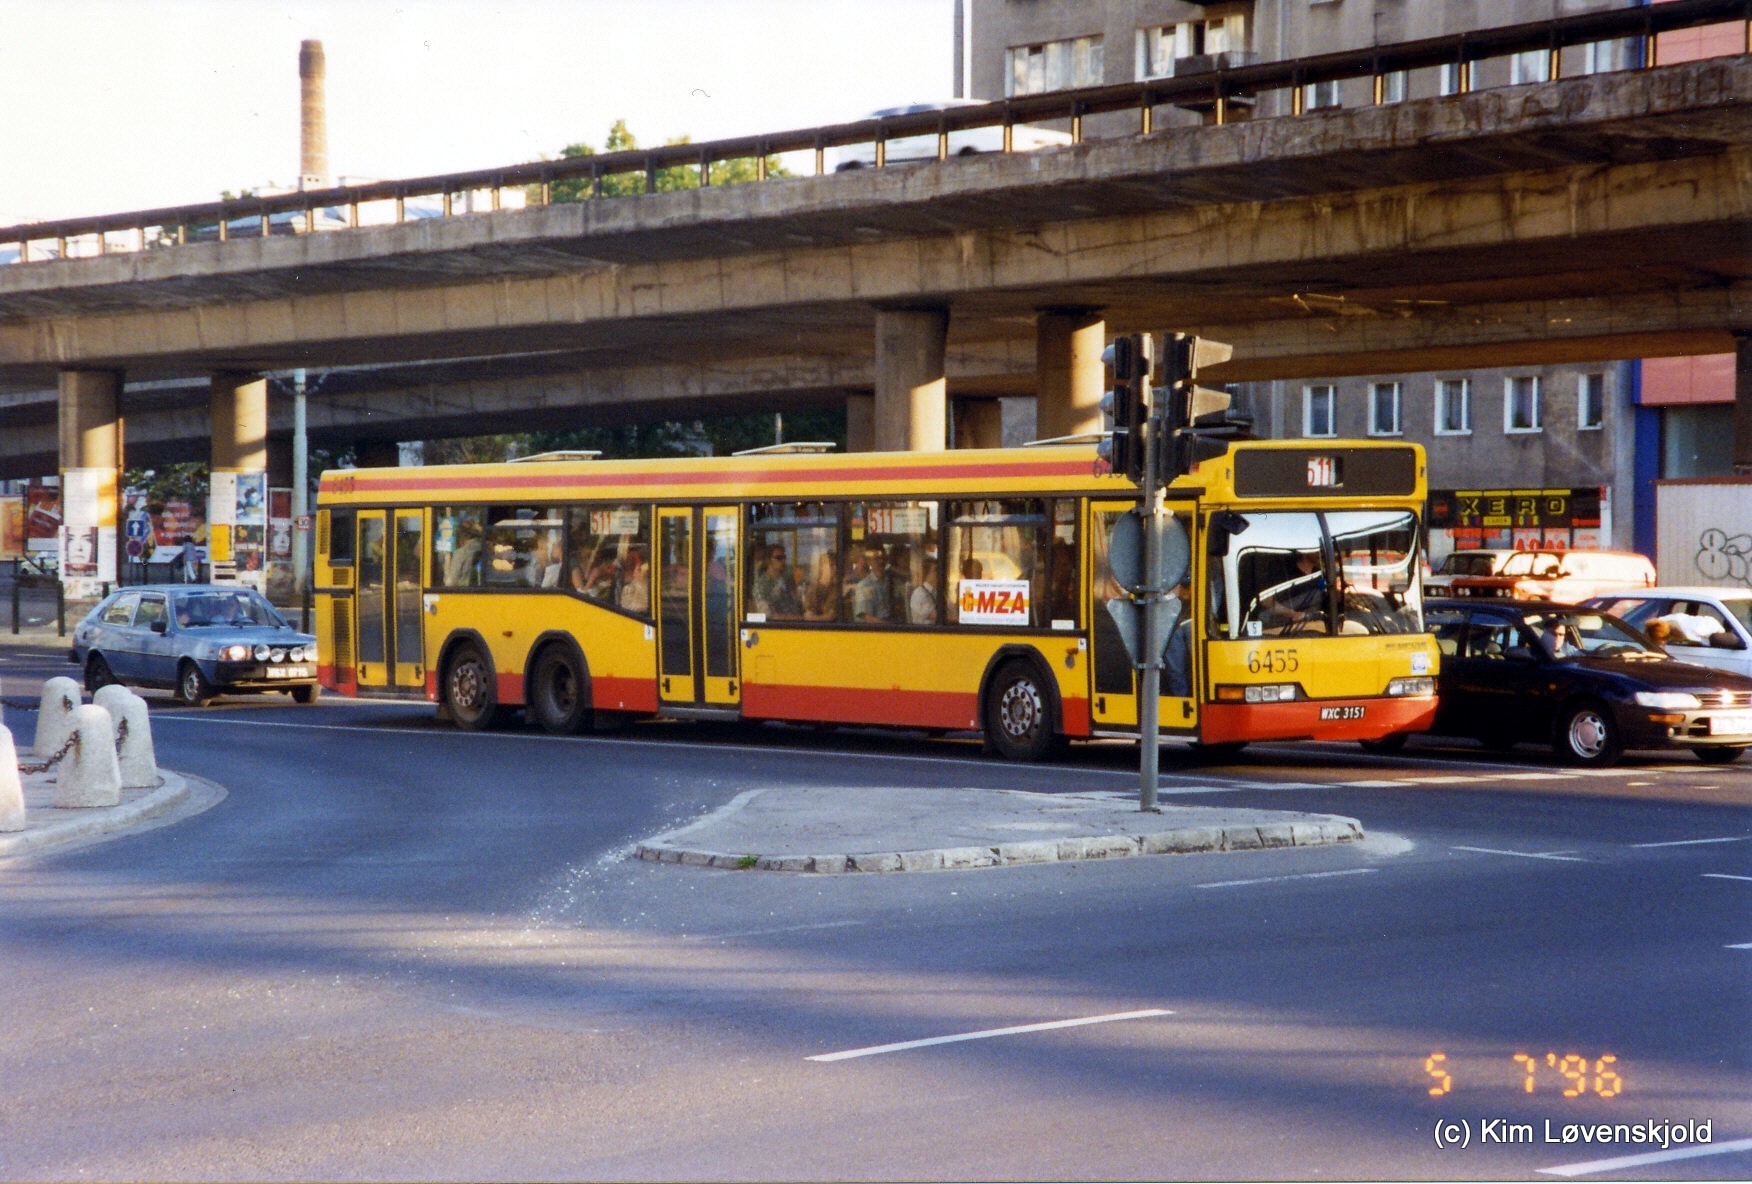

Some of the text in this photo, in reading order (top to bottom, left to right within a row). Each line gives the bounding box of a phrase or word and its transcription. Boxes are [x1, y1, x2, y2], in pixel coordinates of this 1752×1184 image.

[1307, 457, 1331, 486] 511
[1461, 498, 1566, 515] XERO
[591, 511, 611, 534] 511
[869, 508, 893, 535] 511
[977, 590, 1026, 614] MZA
[1248, 649, 1299, 674] 6455
[1321, 706, 1366, 720] WXC 3151
